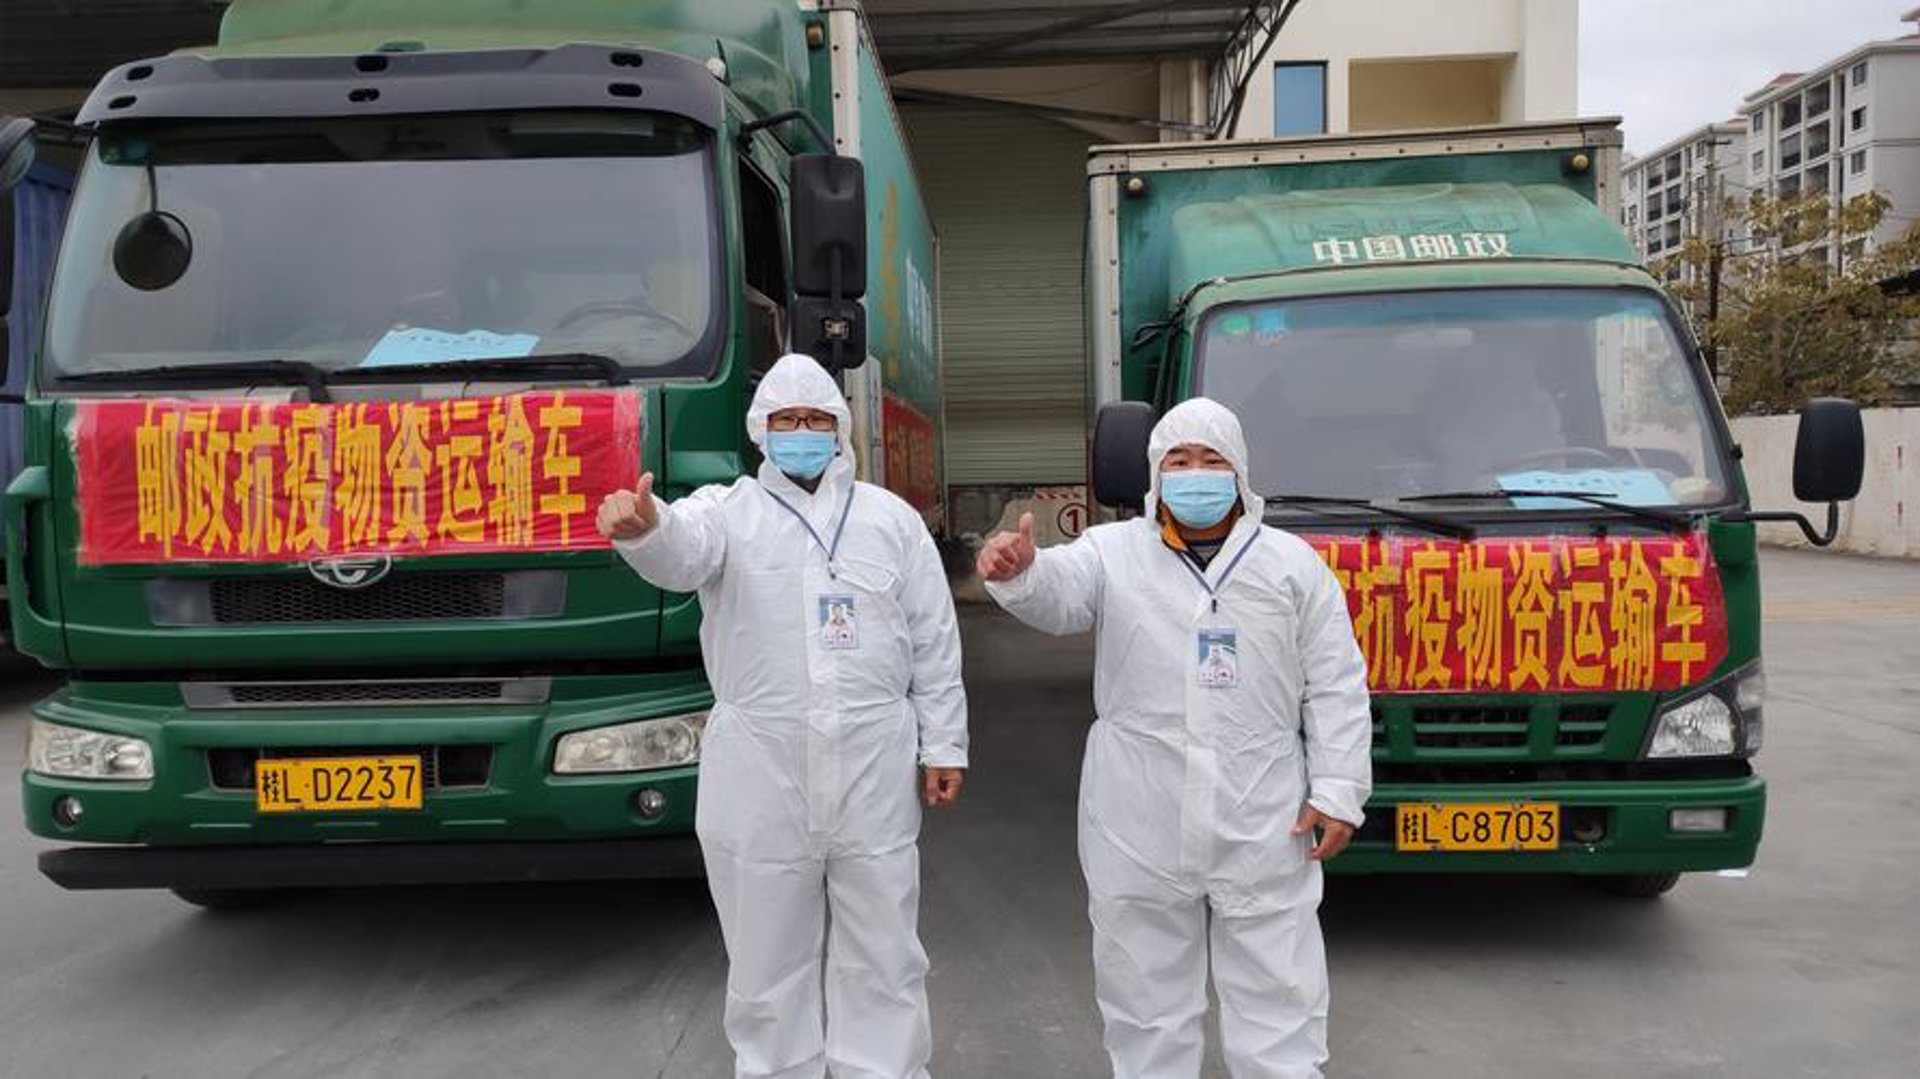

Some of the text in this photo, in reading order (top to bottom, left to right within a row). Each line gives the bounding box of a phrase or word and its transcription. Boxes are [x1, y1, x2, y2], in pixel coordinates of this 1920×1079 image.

[1312, 231, 1513, 265] 中国邮政
[136, 391, 586, 557] 邮政抗疫物资运输车
[1317, 540, 1707, 692] 抗疫物资运输车
